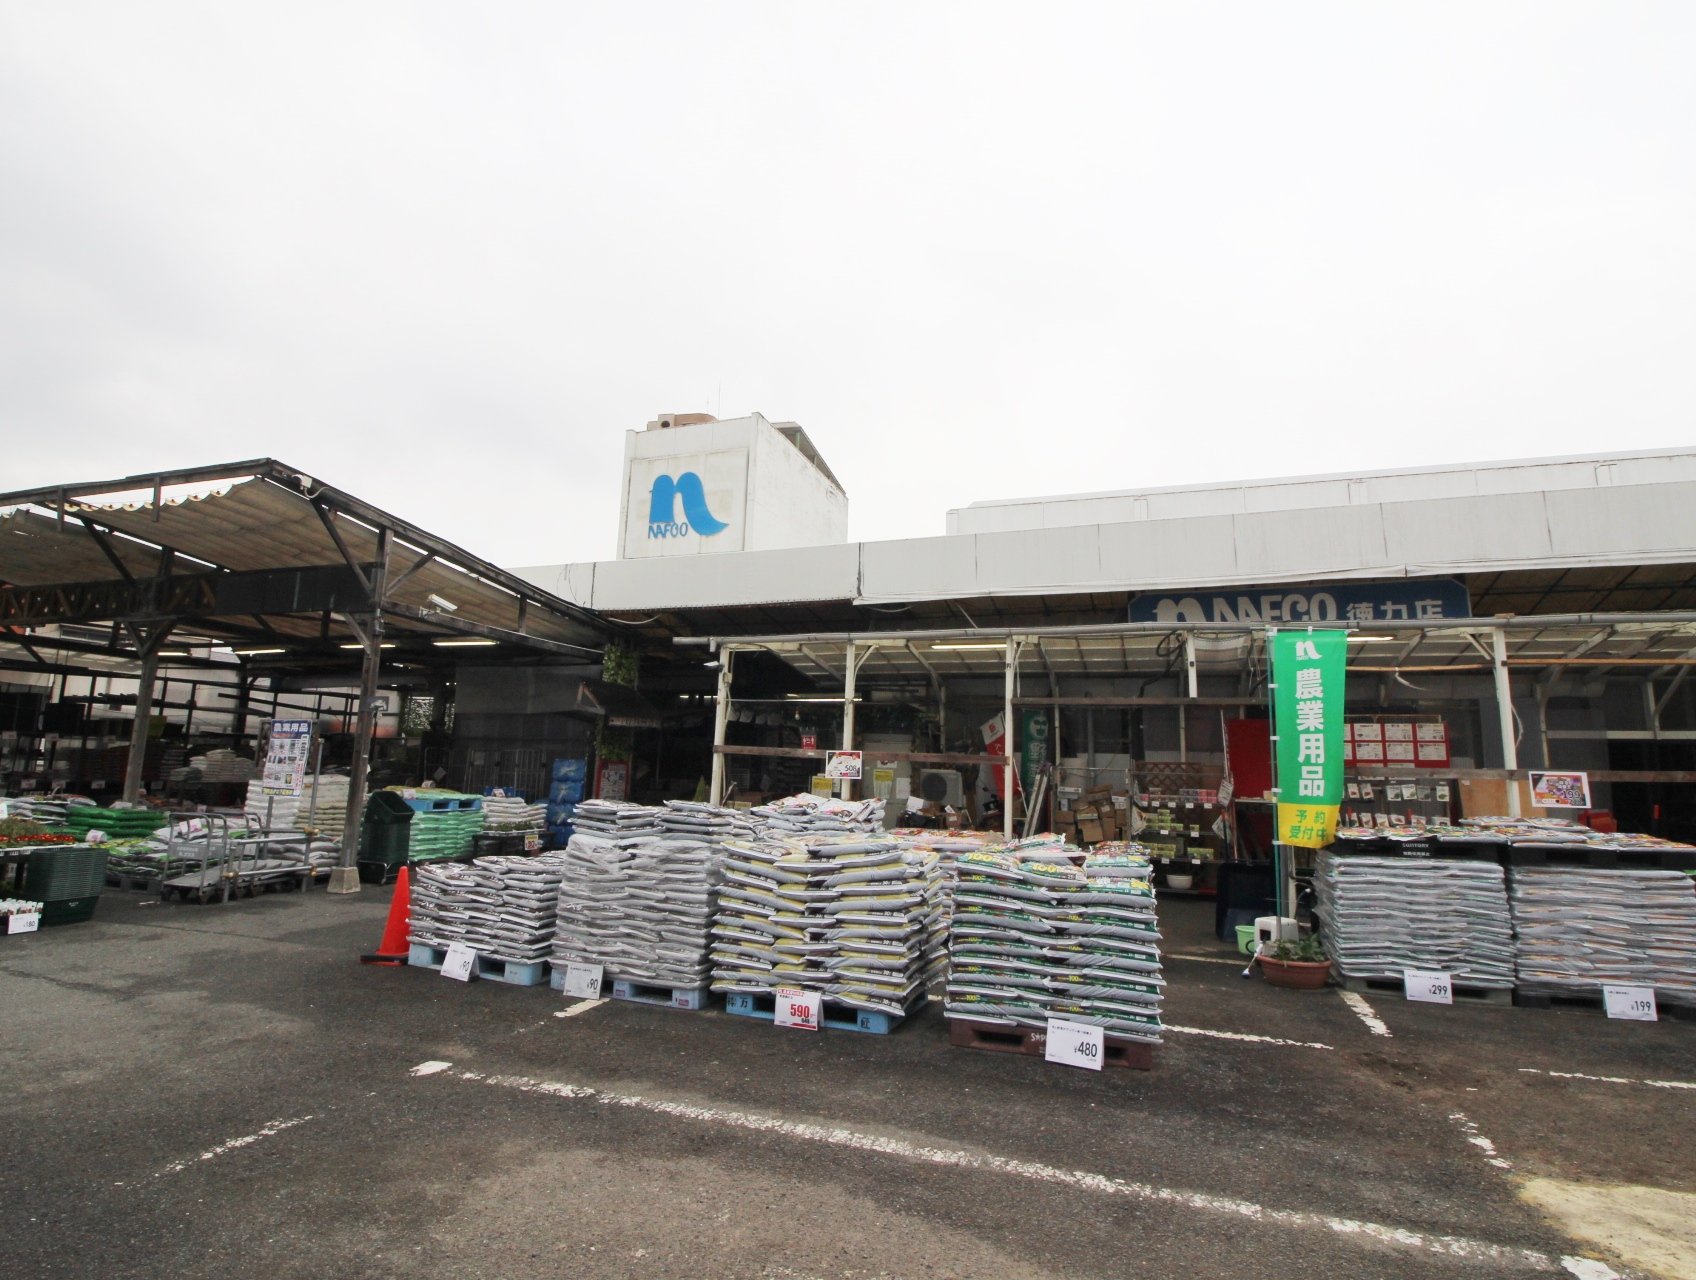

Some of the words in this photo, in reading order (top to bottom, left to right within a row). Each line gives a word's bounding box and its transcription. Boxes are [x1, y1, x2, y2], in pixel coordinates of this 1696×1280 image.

[1296, 668, 1324, 797] 農業用品
[790, 1003, 810, 1019] 590
[1074, 1041, 1098, 1058] ¥480
